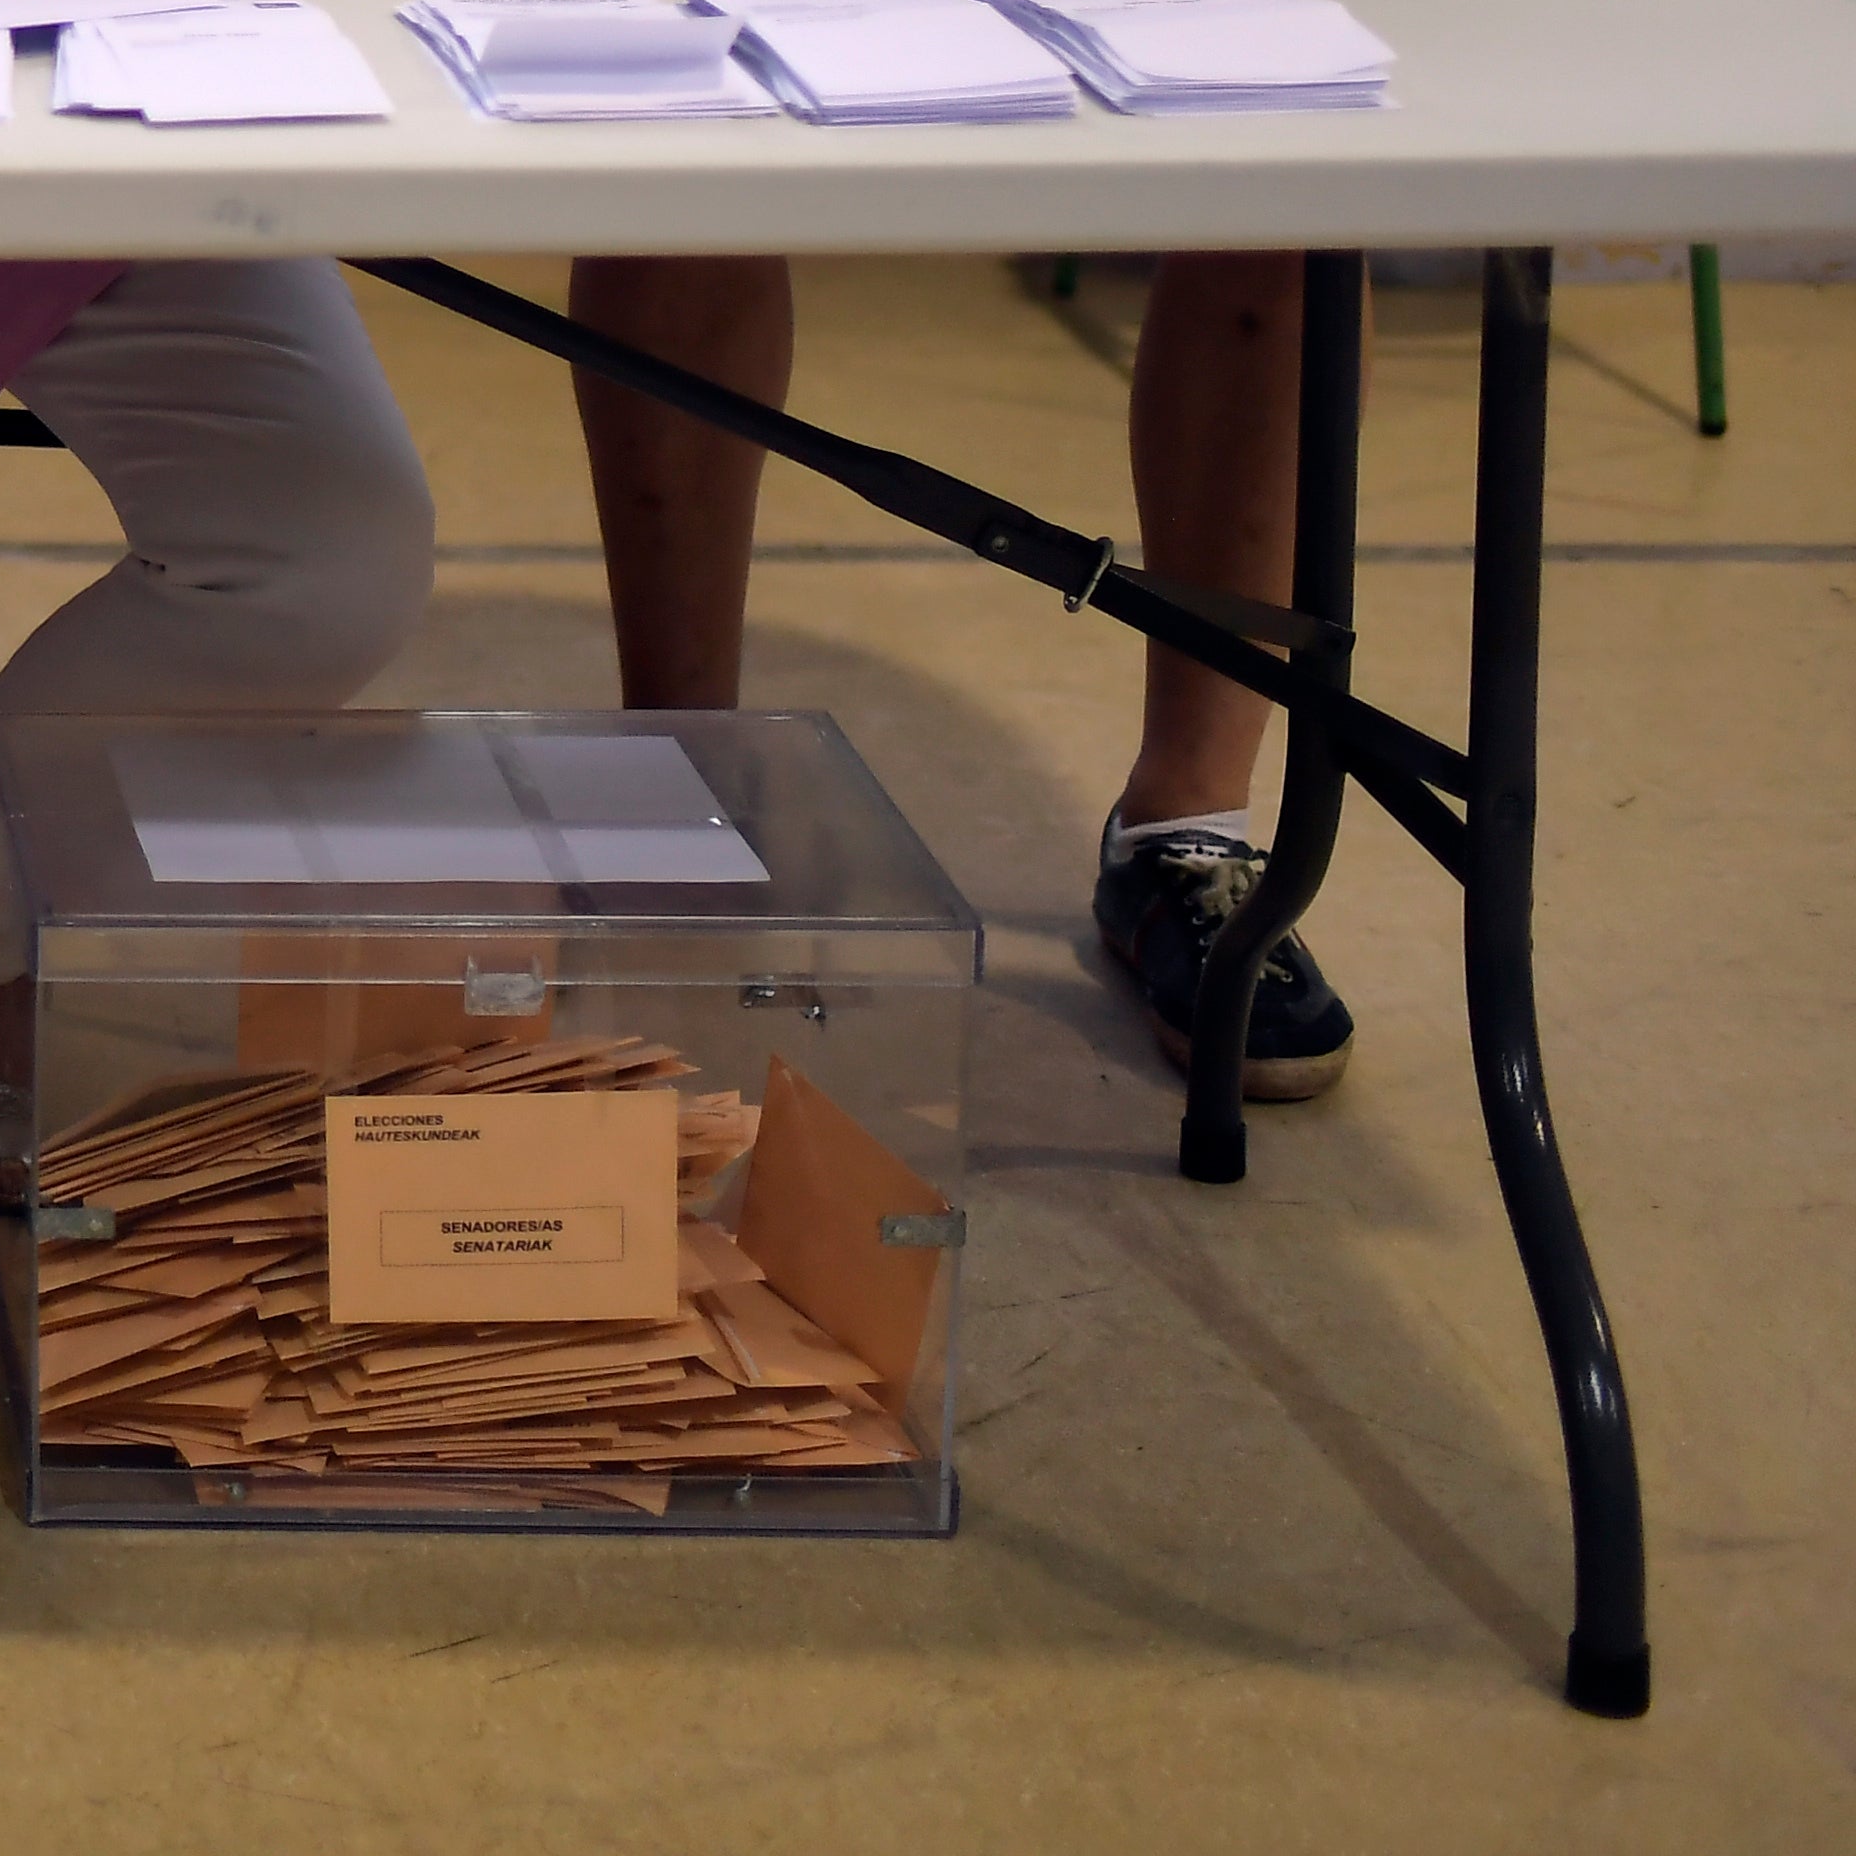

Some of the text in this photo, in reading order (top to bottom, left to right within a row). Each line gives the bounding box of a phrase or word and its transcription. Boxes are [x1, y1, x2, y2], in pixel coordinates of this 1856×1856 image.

[354, 1114, 445, 1128] ELECCIONES
[354, 1129, 482, 1143] HAUTESKUNDEAK
[441, 1219, 564, 1234] SENADORES/AS
[452, 1239, 553, 1254] SENATARIAK
